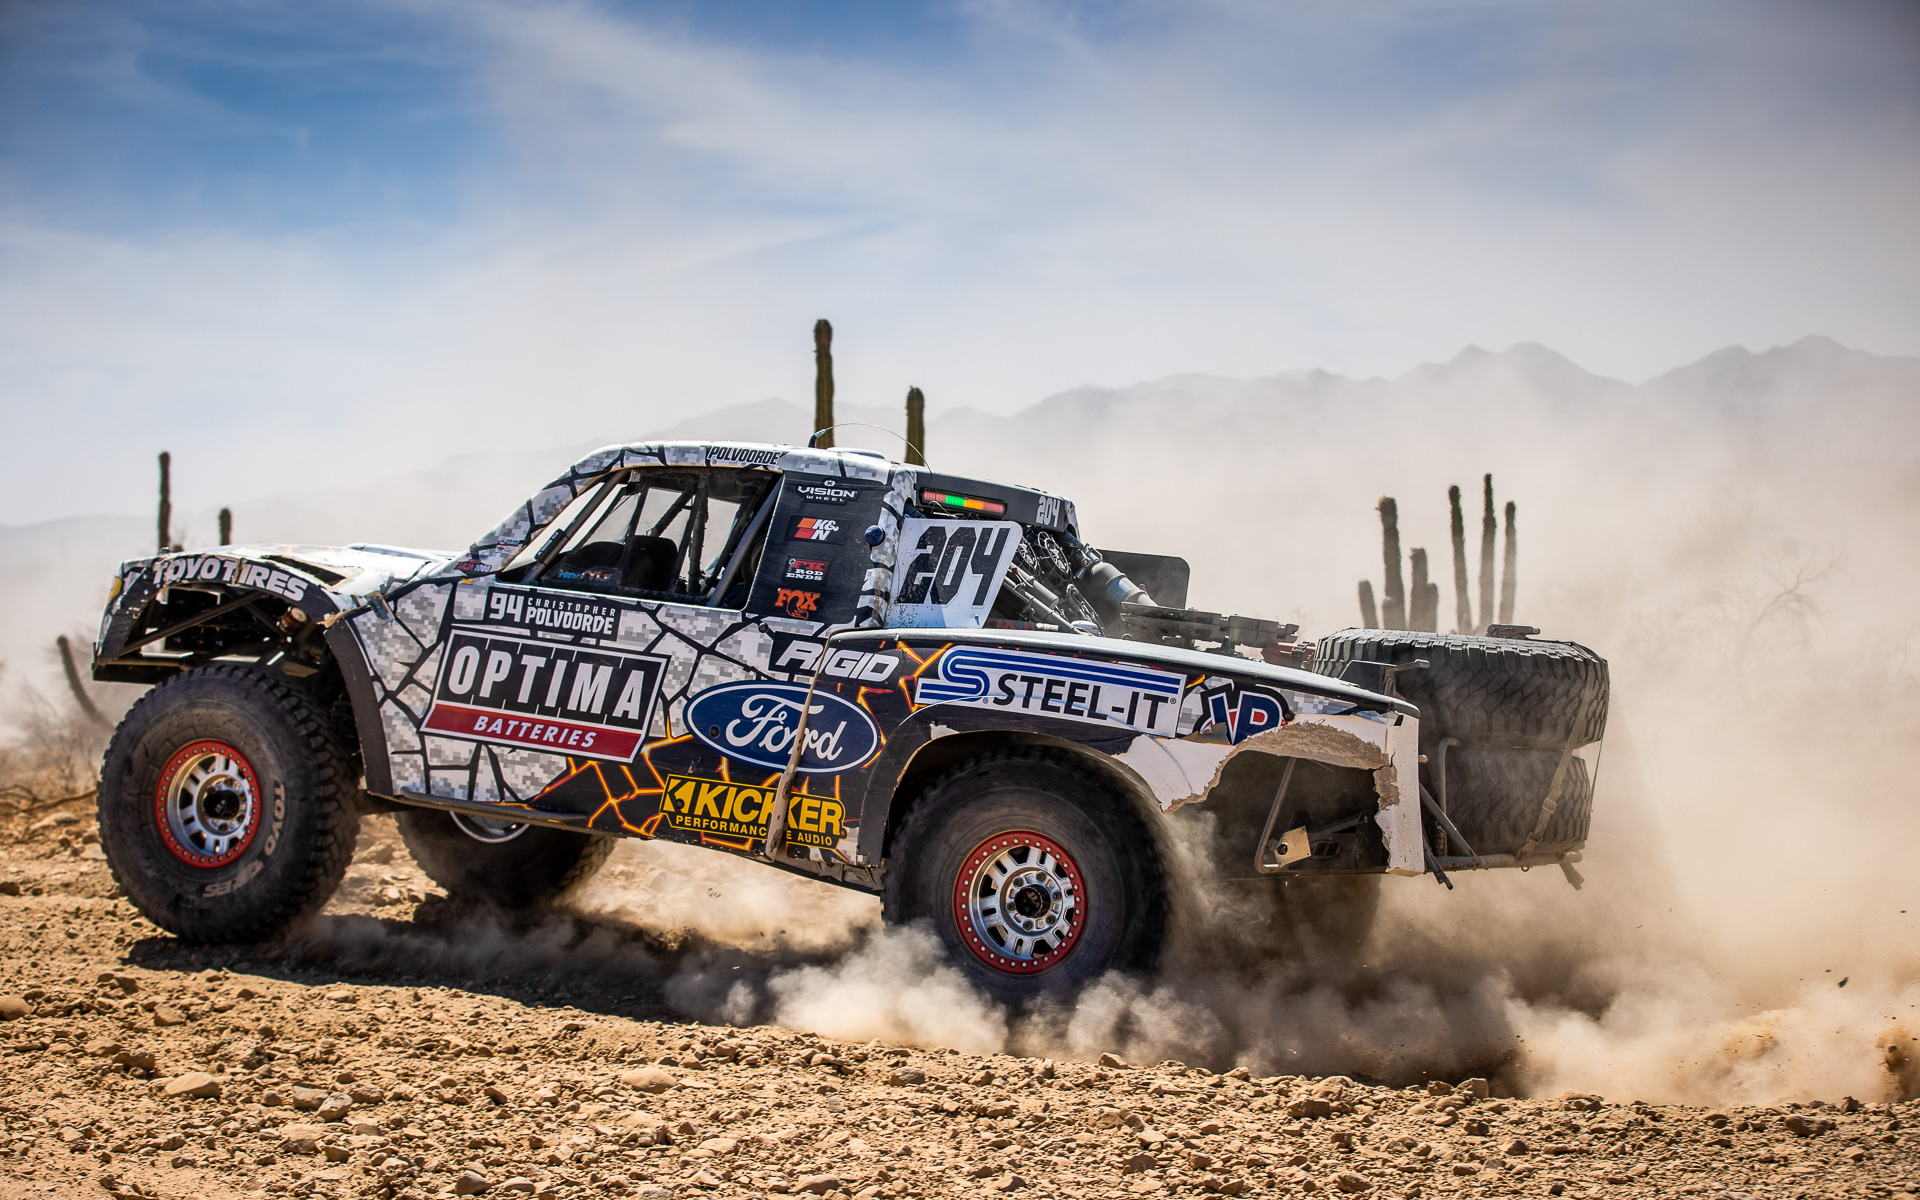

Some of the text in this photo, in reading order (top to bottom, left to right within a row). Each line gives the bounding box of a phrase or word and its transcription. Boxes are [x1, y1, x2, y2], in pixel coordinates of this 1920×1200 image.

[708, 446, 780, 465] POLVOORDE
[797, 485, 856, 498] VISION
[806, 495, 845, 503] WHEEL
[1035, 495, 1061, 528] 204
[153, 557, 309, 602] TOYO TIRES
[474, 564, 491, 573] 1000
[785, 572, 823, 581] ENDS
[795, 568, 824, 576] ROD
[897, 526, 1011, 606] 204
[489, 592, 524, 622] 94
[527, 597, 616, 617] CHRISTOPHER
[774, 588, 821, 612] FOX
[525, 606, 615, 635] POLVOORDE
[775, 640, 900, 682] RIGID
[448, 645, 645, 720] OPTIMA
[993, 673, 1170, 730] STEEL-IT
[473, 715, 597, 748] BATTERIES
[725, 694, 848, 761] Ford
[264, 783, 286, 857] TOYO
[693, 782, 843, 836] KICKER
[797, 832, 833, 846] AUDIO
